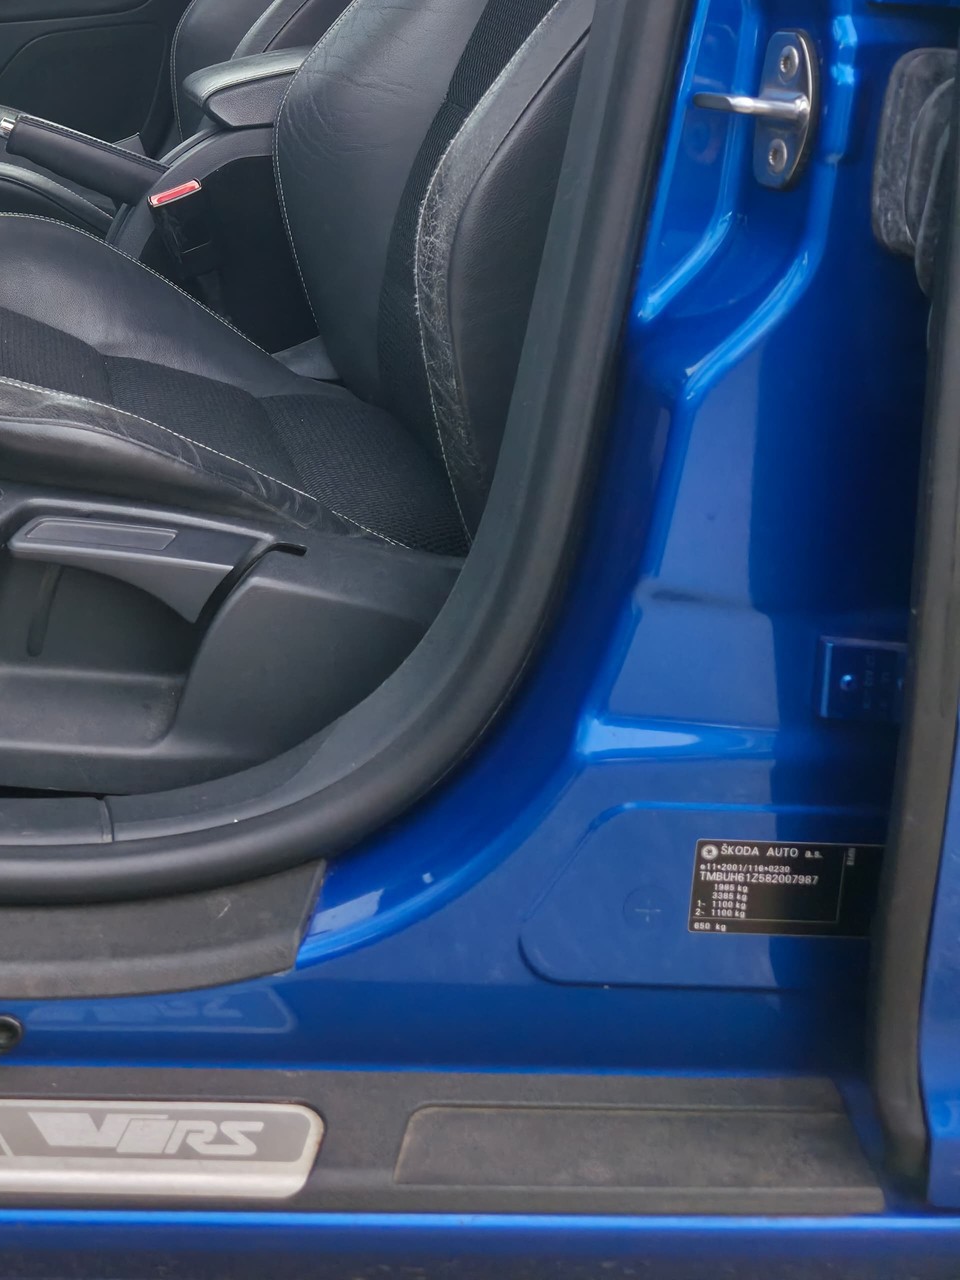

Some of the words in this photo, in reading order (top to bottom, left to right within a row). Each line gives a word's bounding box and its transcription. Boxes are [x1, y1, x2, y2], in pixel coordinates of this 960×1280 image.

[721, 843, 759, 856] ŠKODA
[766, 846, 799, 858] AUTO
[737, 884, 748, 893] kg
[736, 892, 747, 901] kg
[712, 900, 733, 908] 1100
[735, 901, 746, 910] kg
[711, 909, 732, 917] 1100
[734, 910, 745, 919] kg
[715, 923, 726, 932] kg
